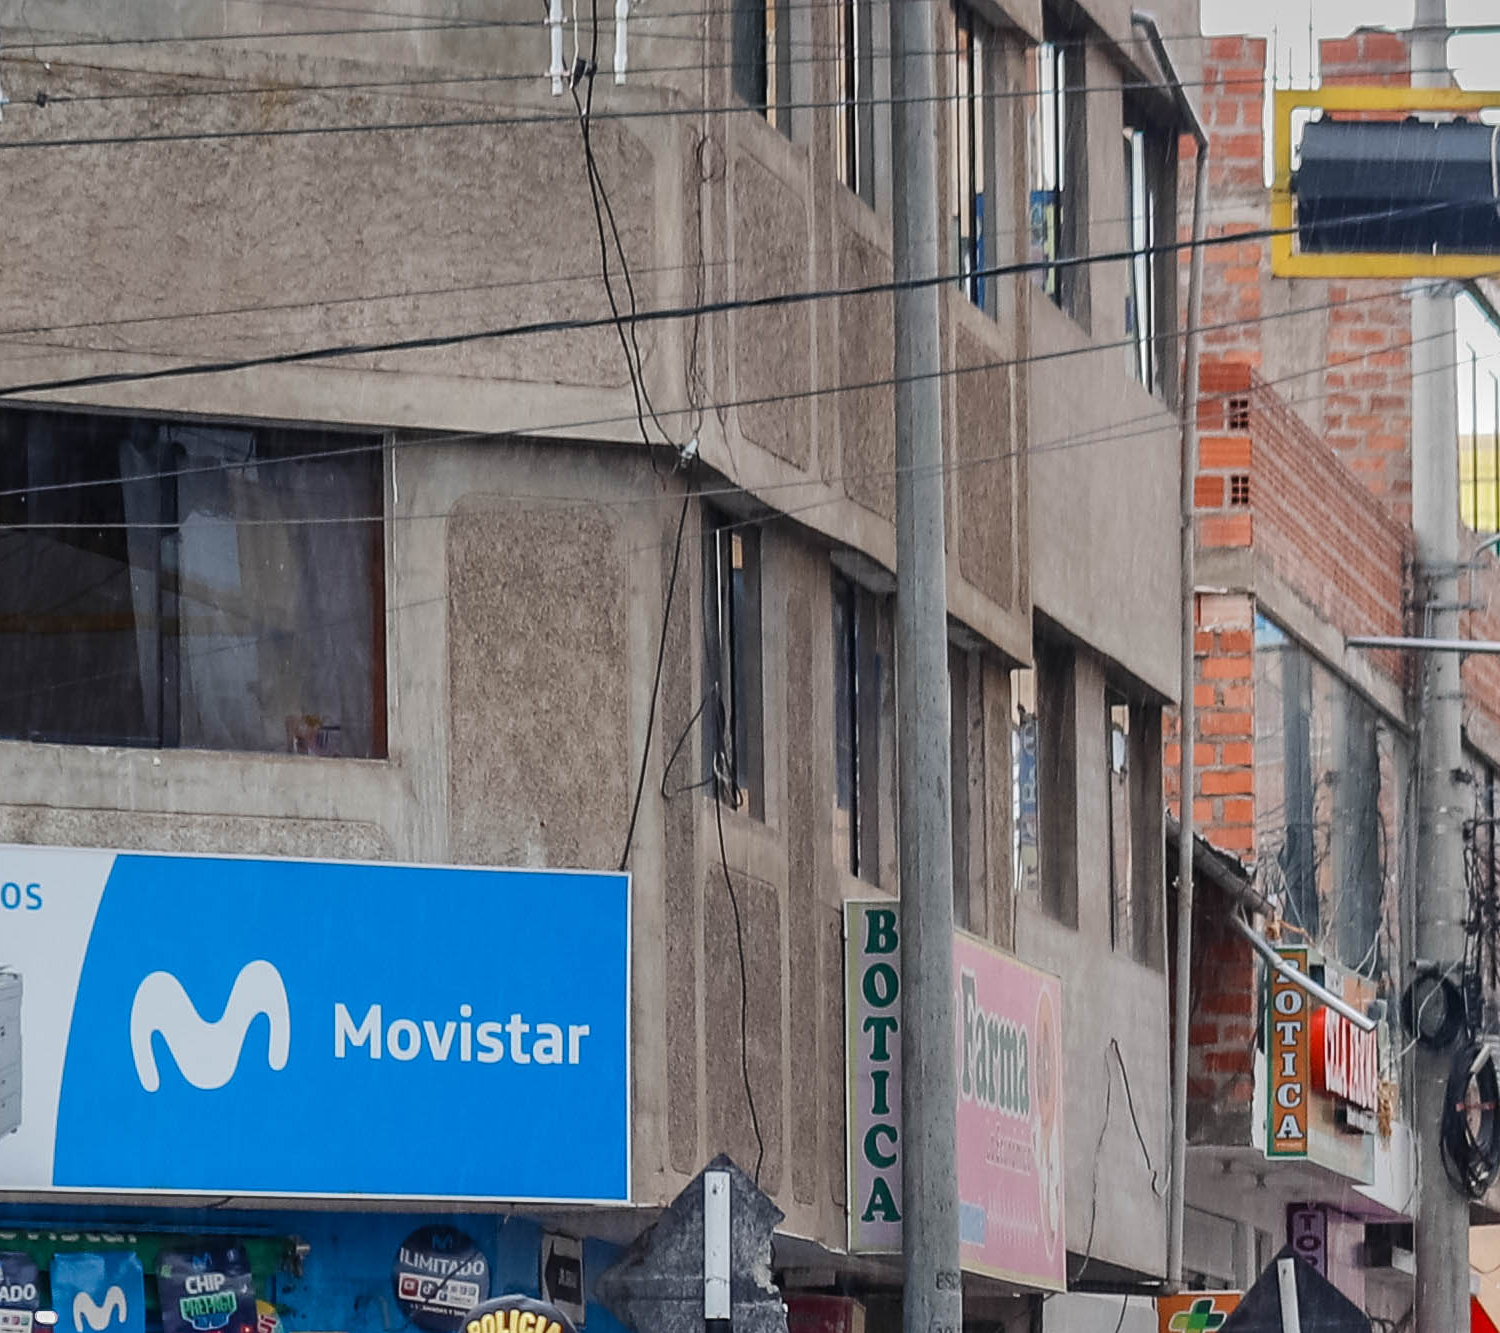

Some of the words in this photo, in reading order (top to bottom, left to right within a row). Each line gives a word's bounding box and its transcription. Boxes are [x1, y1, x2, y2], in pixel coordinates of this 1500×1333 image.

[333, 1002, 590, 1066] Movistar
[861, 908, 901, 1223] BOTICA
[960, 966, 1030, 1118] Farma
[184, 1274, 226, 1296] CHIP
[399, 1247, 485, 1276] ILIMITADO
